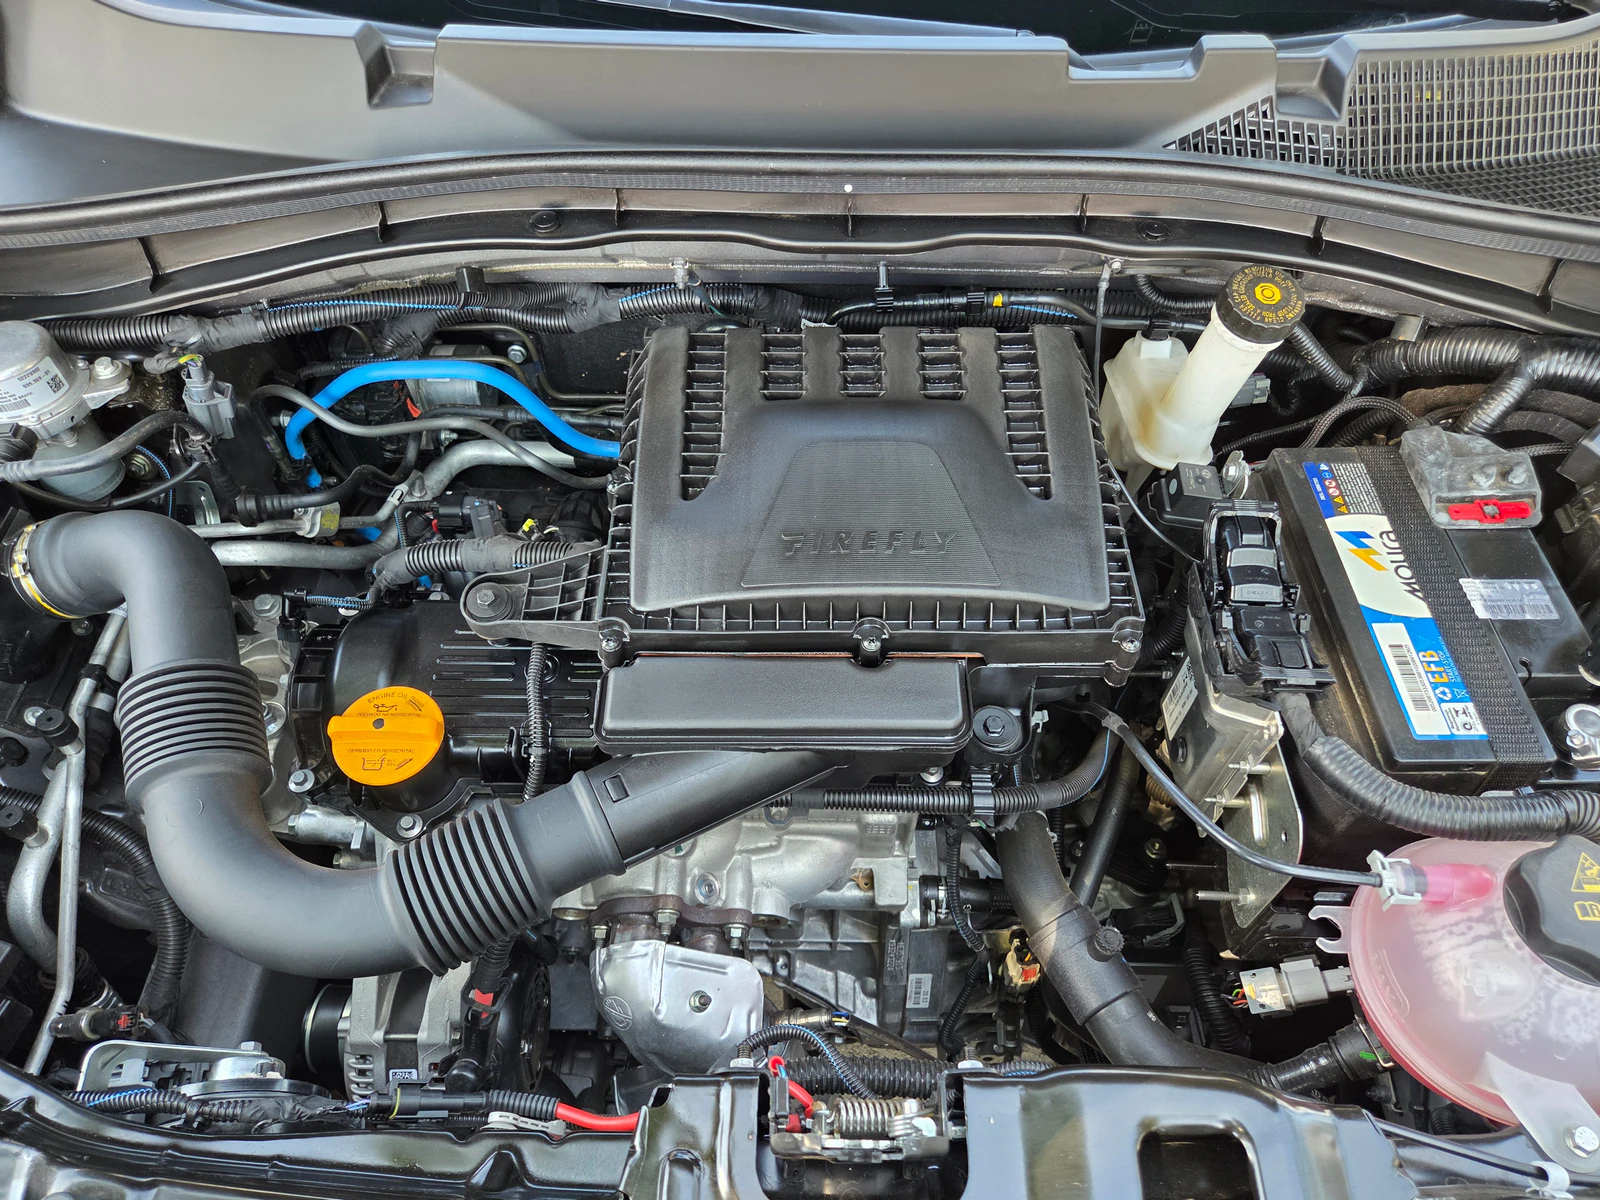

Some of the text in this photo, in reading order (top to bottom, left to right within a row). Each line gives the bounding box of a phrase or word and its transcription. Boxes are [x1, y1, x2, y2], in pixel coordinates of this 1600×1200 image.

[1232, 272, 1245, 289] BEFORE
[1233, 292, 1241, 302] CAP
[1241, 295, 1255, 310] SEALED
[1239, 304, 1261, 320] FILLER
[1278, 305, 1292, 316] FLUID
[782, 530, 958, 555] FIREFLY
[1419, 650, 1449, 682] EFB
[1438, 650, 1457, 682] START-STOP
[368, 692, 395, 703] ENGINE
